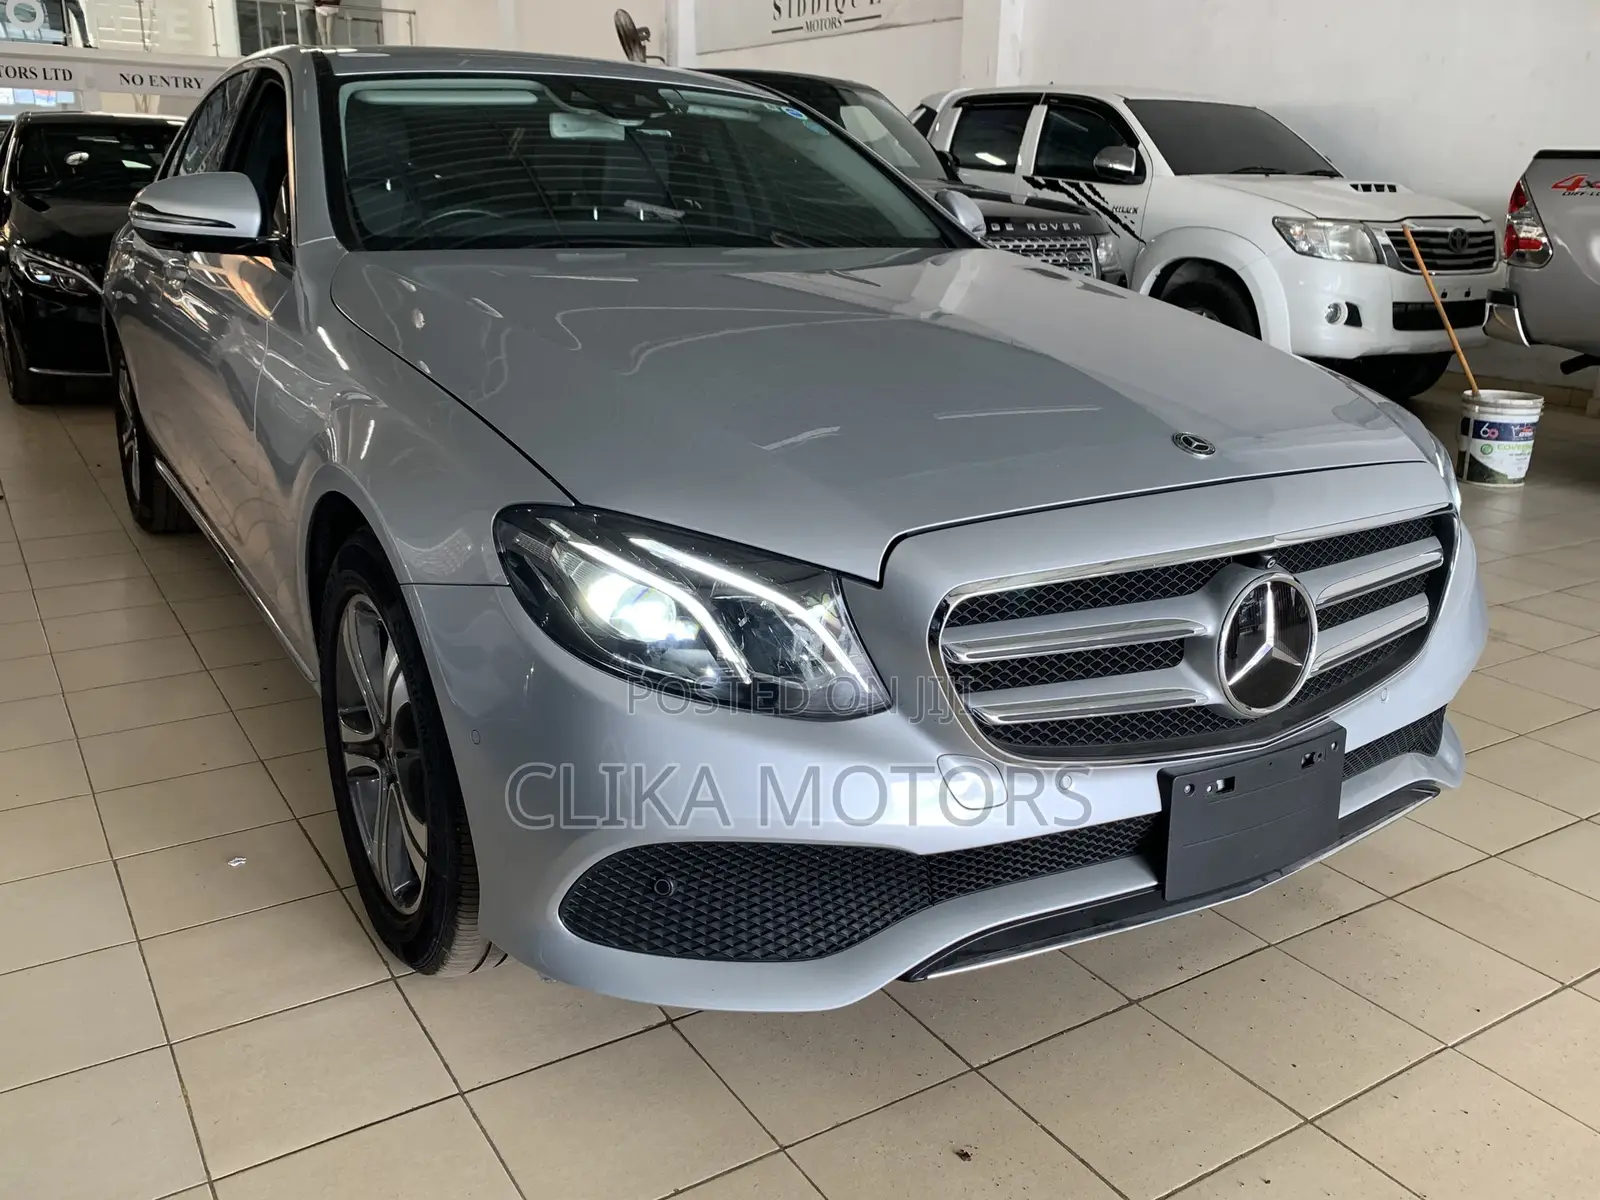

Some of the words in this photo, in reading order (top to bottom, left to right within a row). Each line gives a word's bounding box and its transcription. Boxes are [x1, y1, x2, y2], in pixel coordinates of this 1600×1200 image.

[804, 16, 843, 33] MOTORS
[42, 67, 73, 82] LTD
[119, 72, 144, 87] NO
[149, 74, 204, 90] ENTRY
[1112, 205, 1139, 215] HILUX
[1026, 222, 1082, 232] ROVER
